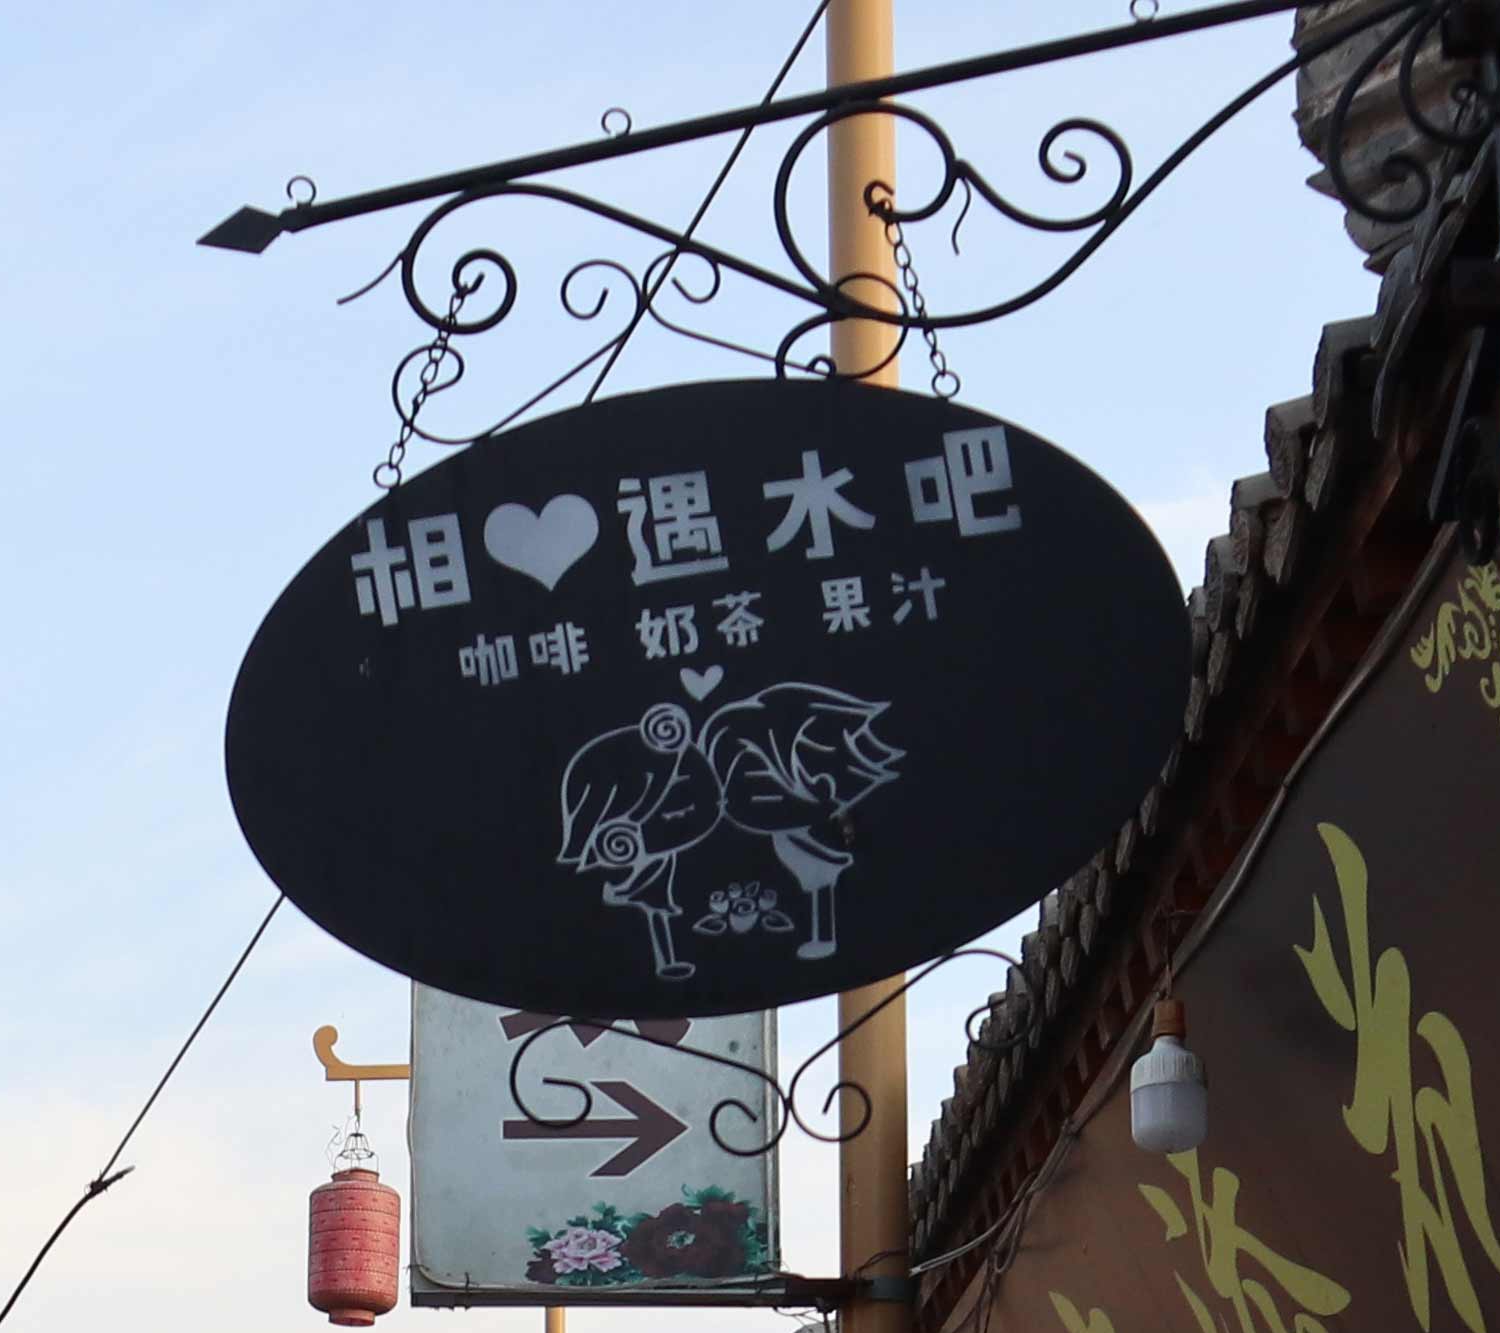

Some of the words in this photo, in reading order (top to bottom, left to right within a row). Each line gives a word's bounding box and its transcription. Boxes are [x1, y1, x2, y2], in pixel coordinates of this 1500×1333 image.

[350, 426, 1023, 627] 相遇水吧
[458, 622, 590, 687] 咖啡
[634, 590, 765, 661] 奶茶
[821, 568, 948, 635] 果汁
